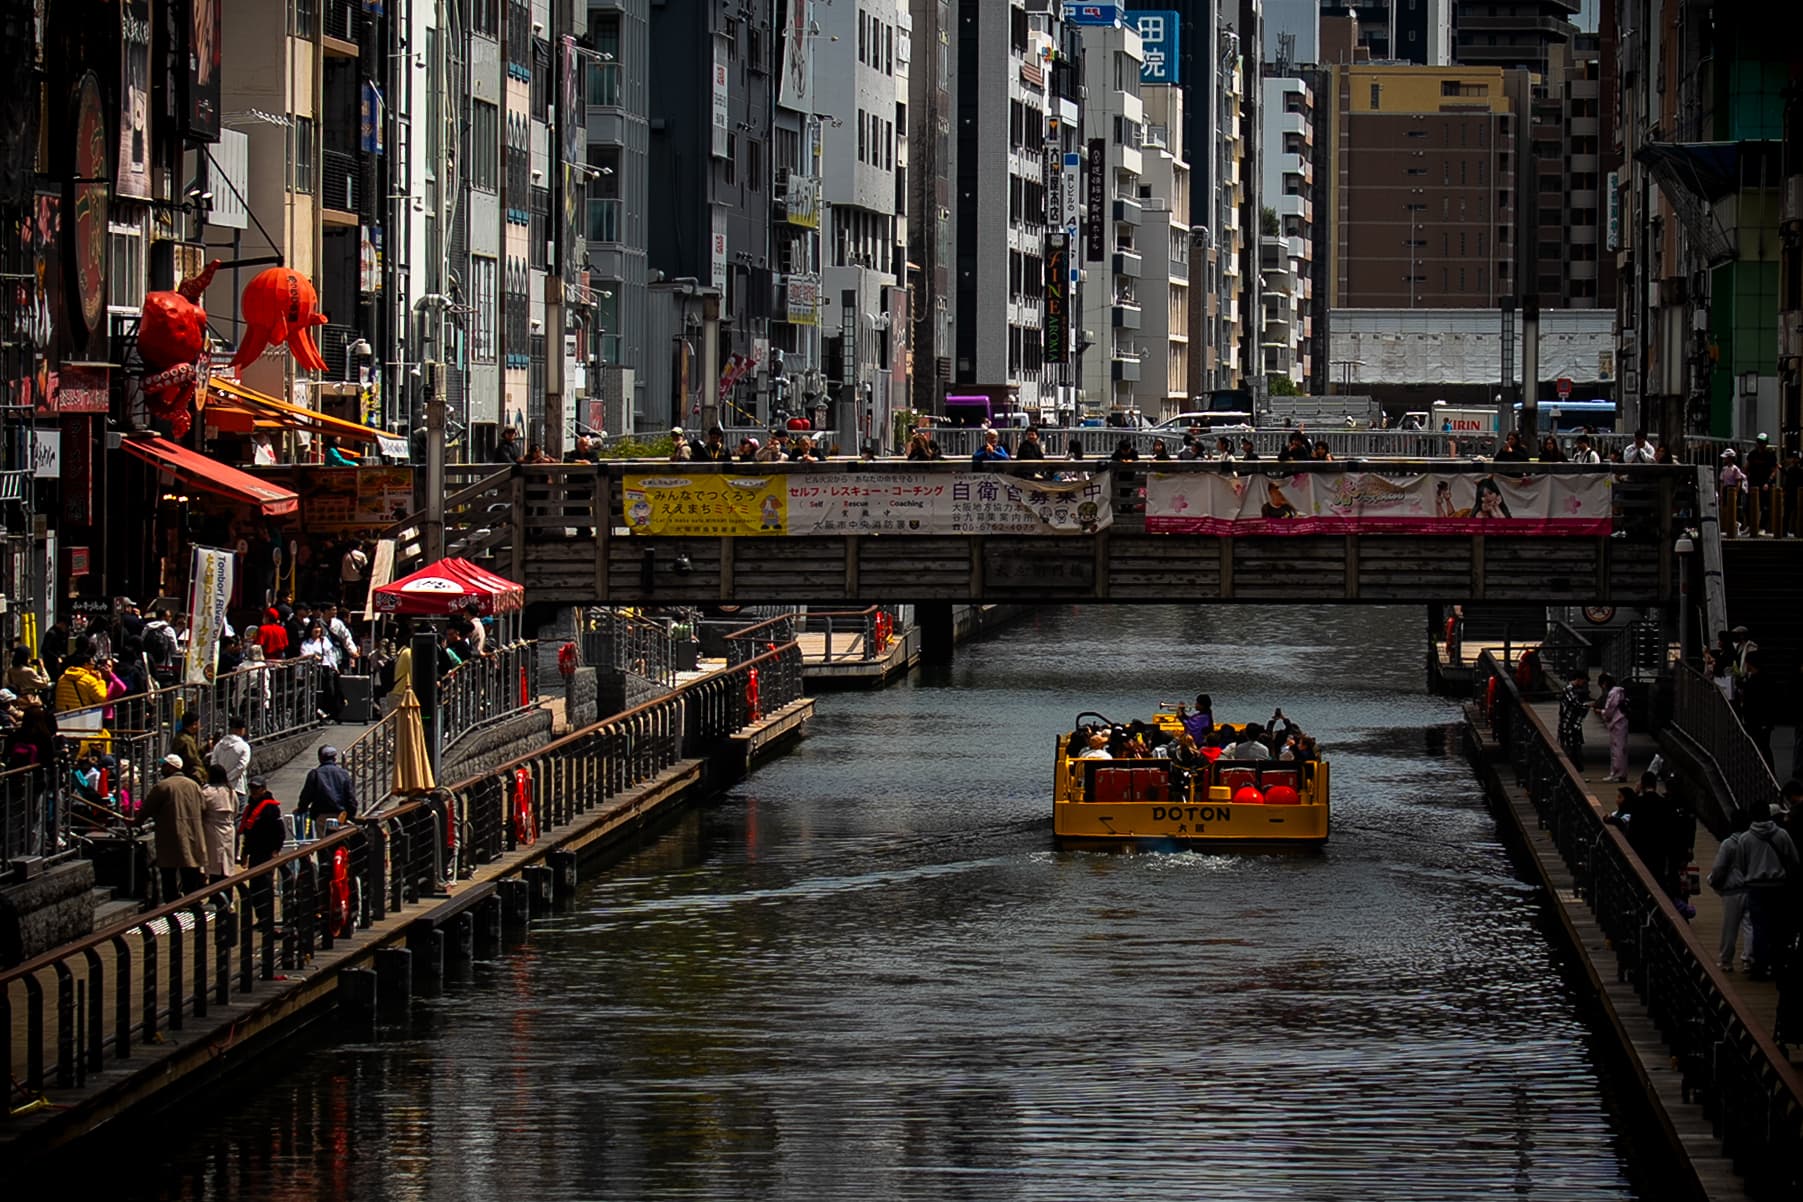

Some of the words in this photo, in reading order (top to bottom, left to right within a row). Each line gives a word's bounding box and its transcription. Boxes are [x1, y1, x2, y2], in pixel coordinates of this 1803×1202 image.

[1449, 419, 1481, 431] IRIN
[654, 490, 756, 501] みんなでつくろう
[789, 486, 944, 497] セルフ・レスキュー・コーチング
[661, 503, 750, 515] ええまちミナミ
[889, 500, 924, 509] Coaching
[217, 555, 226, 598] Tombori
[1152, 807, 1231, 822] DOTON
